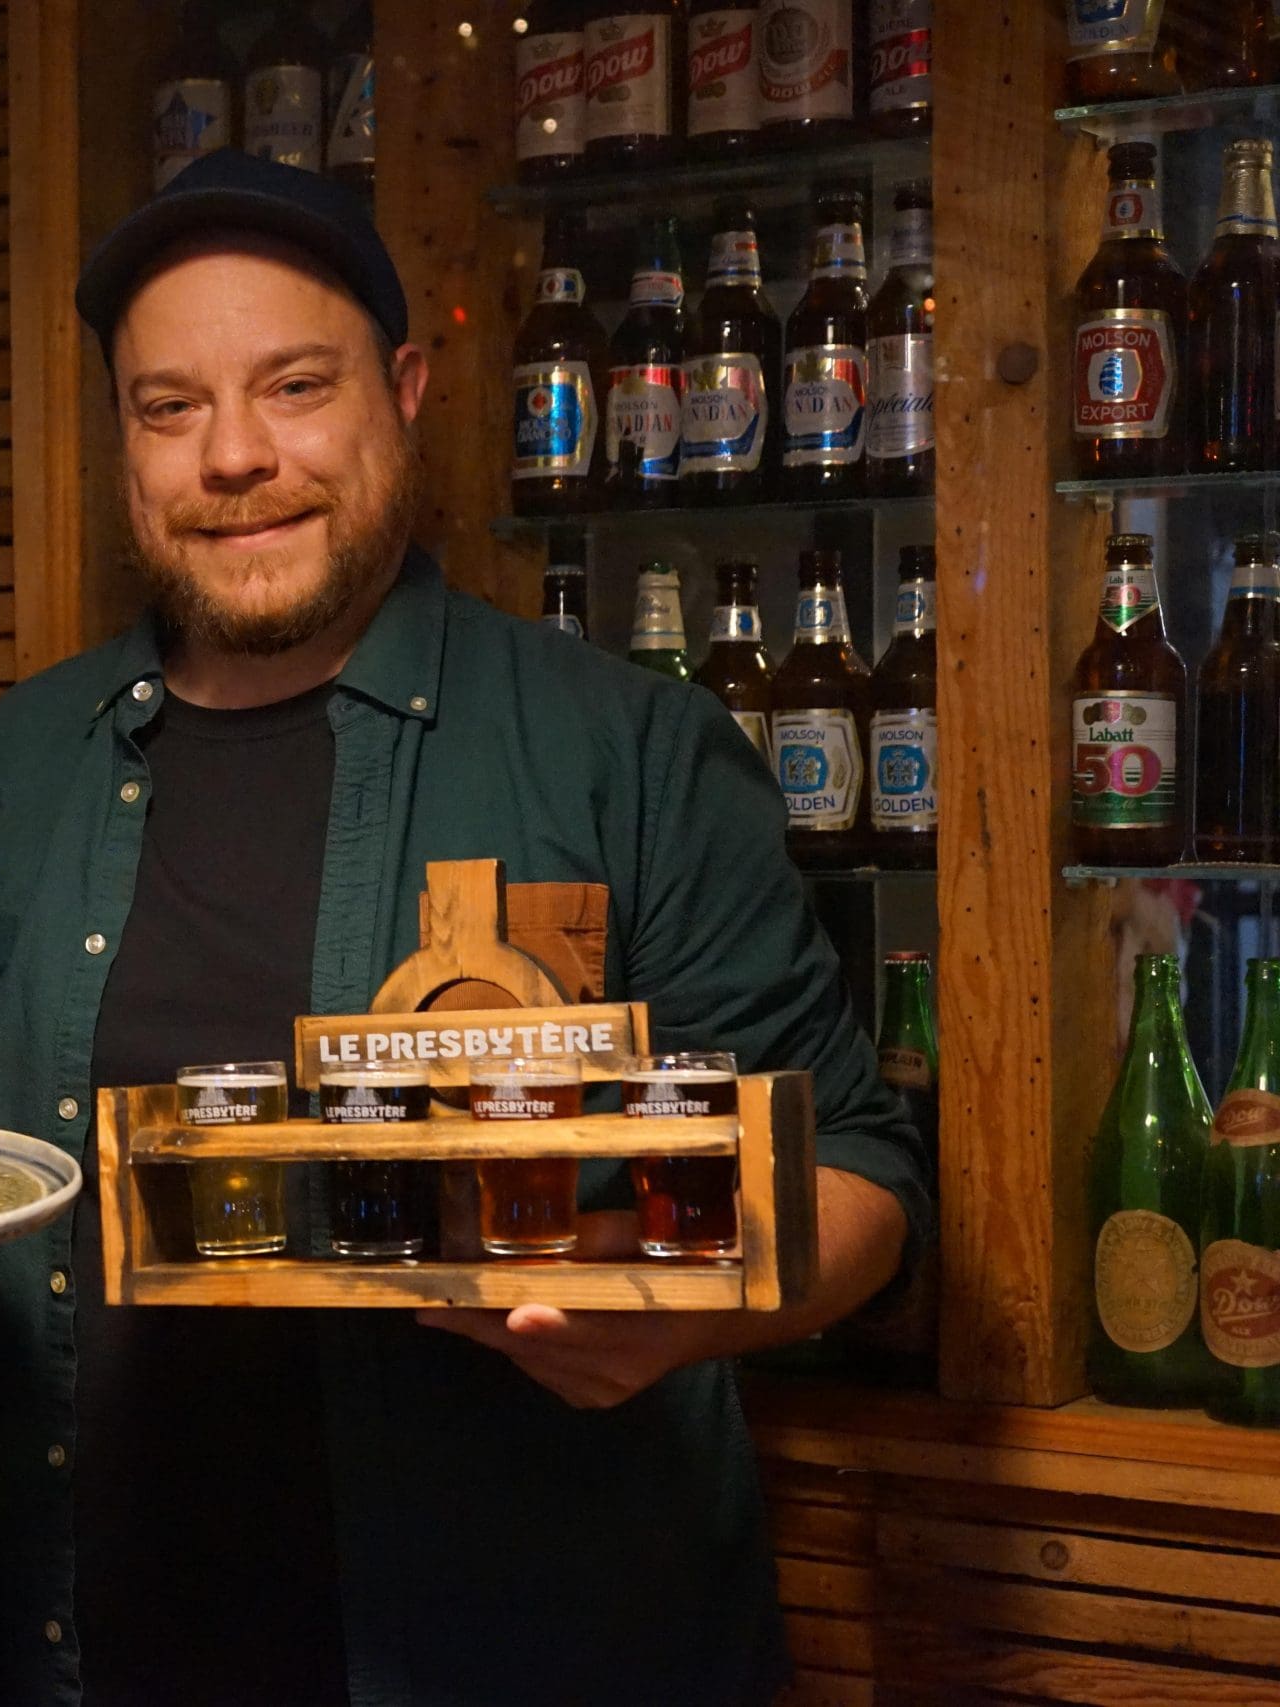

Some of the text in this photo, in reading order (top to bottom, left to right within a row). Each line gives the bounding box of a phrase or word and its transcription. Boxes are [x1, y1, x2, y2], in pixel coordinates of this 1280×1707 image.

[587, 45, 649, 92] Dow
[690, 38, 745, 90] Dow
[520, 62, 581, 107] Dow
[1081, 331, 1151, 352] MOLSON
[1081, 403, 1149, 421] EXPORT
[780, 729, 825, 741] MOLSON
[879, 730, 924, 742] MOLSON
[1089, 727, 1133, 742] Labatt
[1076, 743, 1162, 797] 50
[784, 796, 836, 812] OLDEN
[874, 796, 934, 813] GOLDEN
[319, 1021, 614, 1062] LE PRESBYTÈRE
[189, 1104, 258, 1120] PRESBYTÈRE
[335, 1104, 407, 1118] PRESBYTÈRE
[483, 1099, 556, 1114] PRESBYTÈRE
[635, 1099, 710, 1115] PRESBYTÈRE
